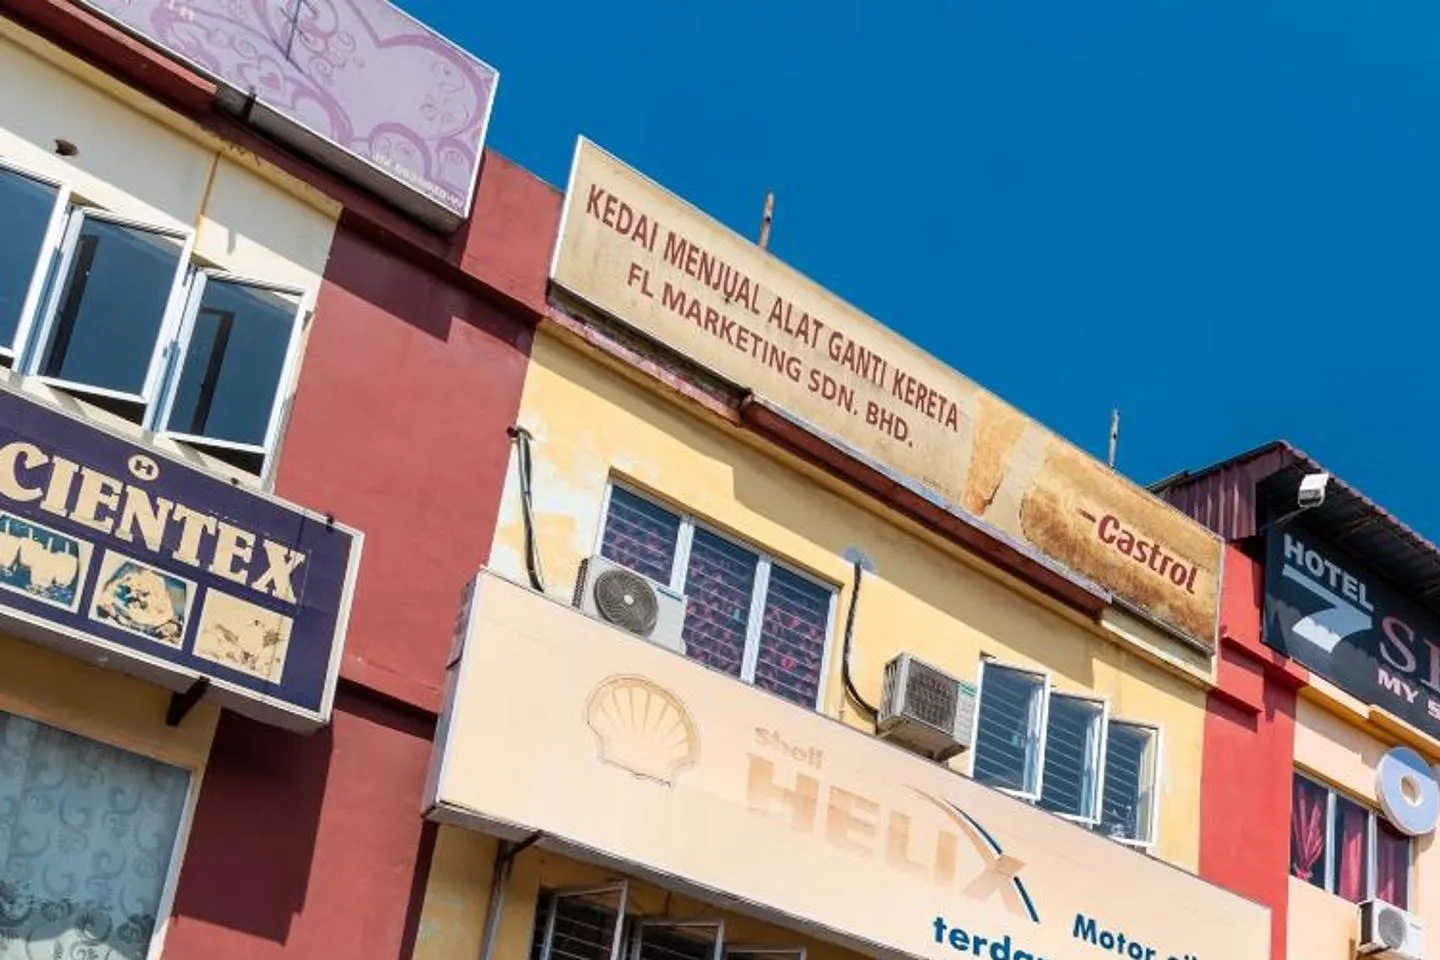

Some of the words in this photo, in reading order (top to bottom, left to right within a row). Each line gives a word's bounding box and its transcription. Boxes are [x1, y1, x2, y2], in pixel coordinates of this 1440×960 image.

[585, 183, 659, 253] KEDAI
[664, 231, 760, 314] MENJUAL
[768, 297, 823, 348] ALAT
[829, 331, 888, 388] GANTI
[892, 368, 958, 432] KERETA
[627, 262, 653, 298] FL
[662, 282, 801, 382] MARKETING
[807, 367, 858, 416] SDN.
[866, 401, 913, 447] BHD.
[0, 441, 306, 606] CIENTEX
[1097, 514, 1197, 594] Castrol
[1284, 533, 1374, 612] HOTEL
[1378, 667, 1419, 703] MY
[745, 752, 1039, 923] HELIX
